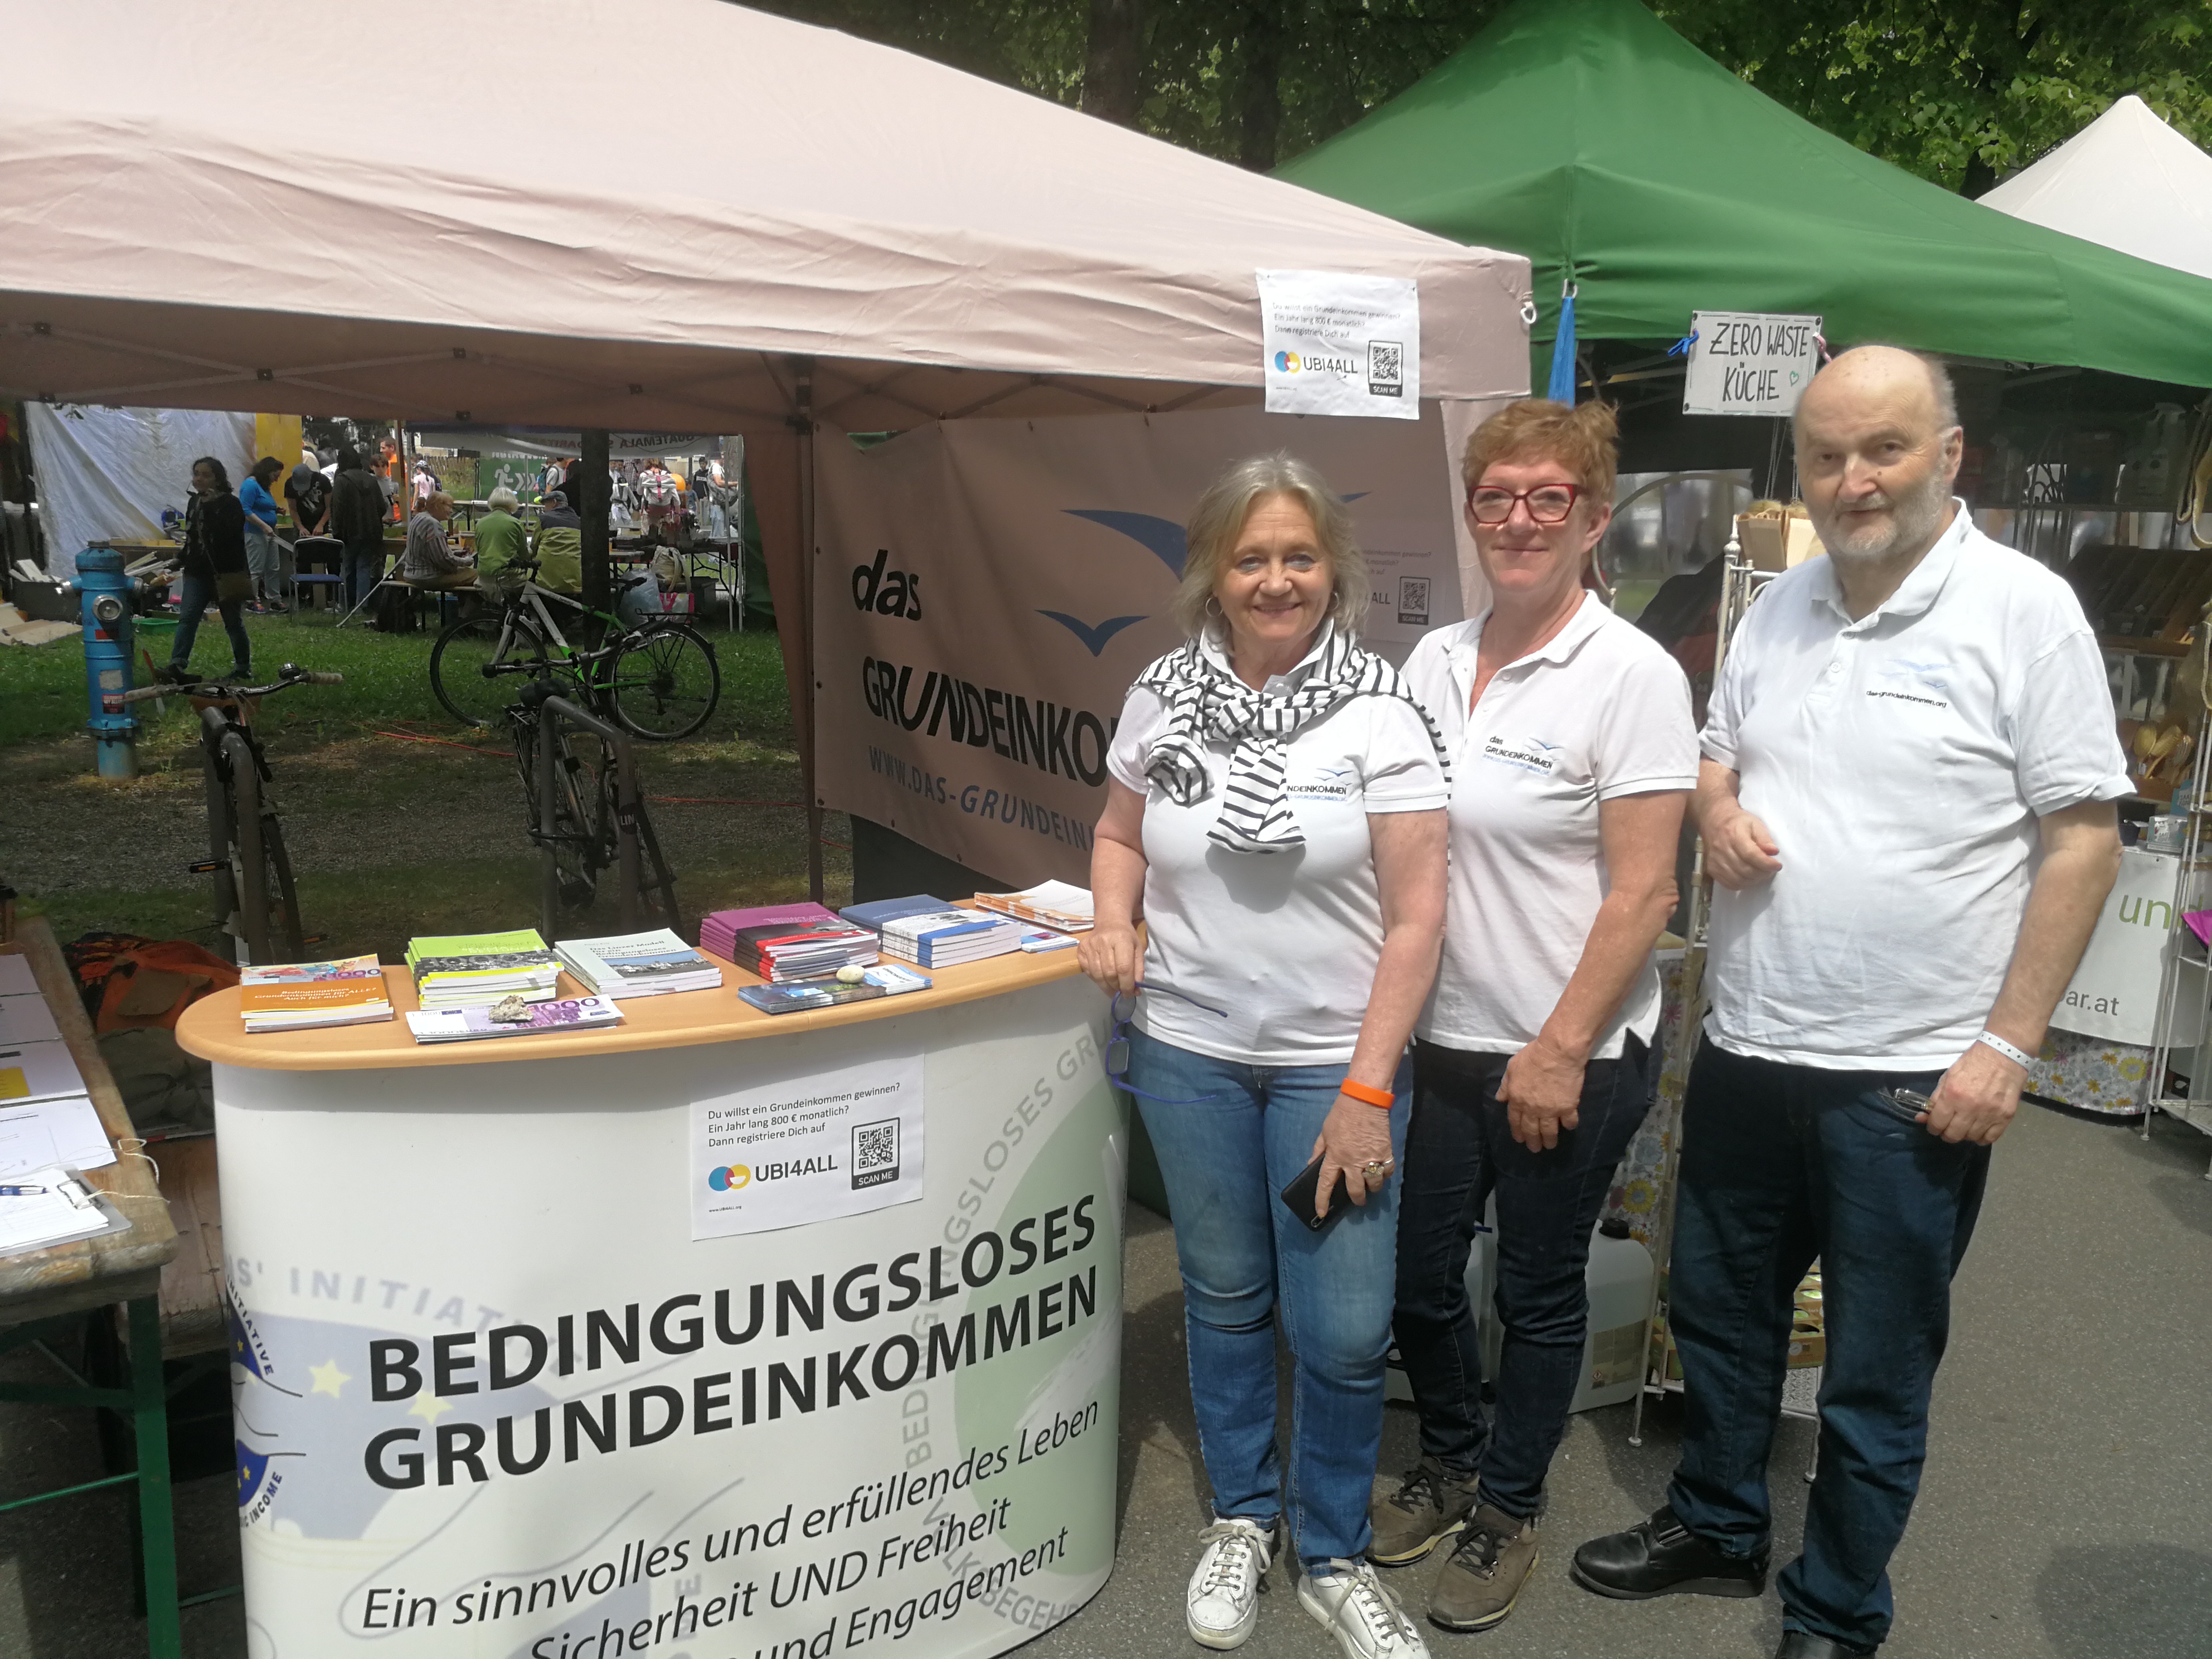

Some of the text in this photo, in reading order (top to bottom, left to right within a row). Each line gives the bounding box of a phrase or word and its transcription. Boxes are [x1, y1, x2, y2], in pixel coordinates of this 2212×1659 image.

[1301, 316, 1313, 326] lang
[1315, 317, 1326, 325] 800
[1333, 319, 1365, 328] monatlich?
[1314, 307, 1367, 317] Grundeinkommen
[1293, 327, 1323, 337] registriere
[1325, 330, 1338, 338] Dich
[1709, 323, 1810, 357] ZERO WASTE
[1303, 356, 1358, 374] UBI4ALL
[1723, 362, 1779, 402] KÜCHE
[851, 549, 922, 621] das
[862, 656, 1119, 788] GRUNDEINKO
[1490, 736, 1503, 745] das
[1485, 746, 1553, 769] GRUNDEINKOMMEN
[868, 745, 1094, 852] WWW.DAS-GRUNDEIN
[1287, 785, 1346, 795] NDEINKOMMEN
[2062, 991, 2119, 1016] ar.at
[708, 1082, 900, 1120] Du willst ein Grundeinkommen gewinnen?
[709, 1105, 850, 1133] Ein Jahr lang 800 € monatlich?
[709, 1122, 826, 1147] Dann registriere Dich auf
[755, 1154, 838, 1182] UBI4ALL
[858, 1171, 893, 1186] SCAN ME
[370, 1194, 1095, 1401] BEDINGUNGSLOSES
[364, 1264, 1096, 1490] GRUNDEINKOMMEN
[249, 1471, 283, 1524] INCOME
[363, 1588, 436, 1629] Ein
[453, 1539, 690, 1624] sinnvolles
[705, 1504, 793, 1562] und
[802, 1444, 1009, 1538] erfüllendes
[1018, 1401, 1098, 1464] Leben
[531, 1582, 758, 1659] Sicherheit
[770, 1550, 867, 1609] UND
[877, 1497, 1011, 1578] Freiheit
[845, 1526, 1068, 1649] Engagement
